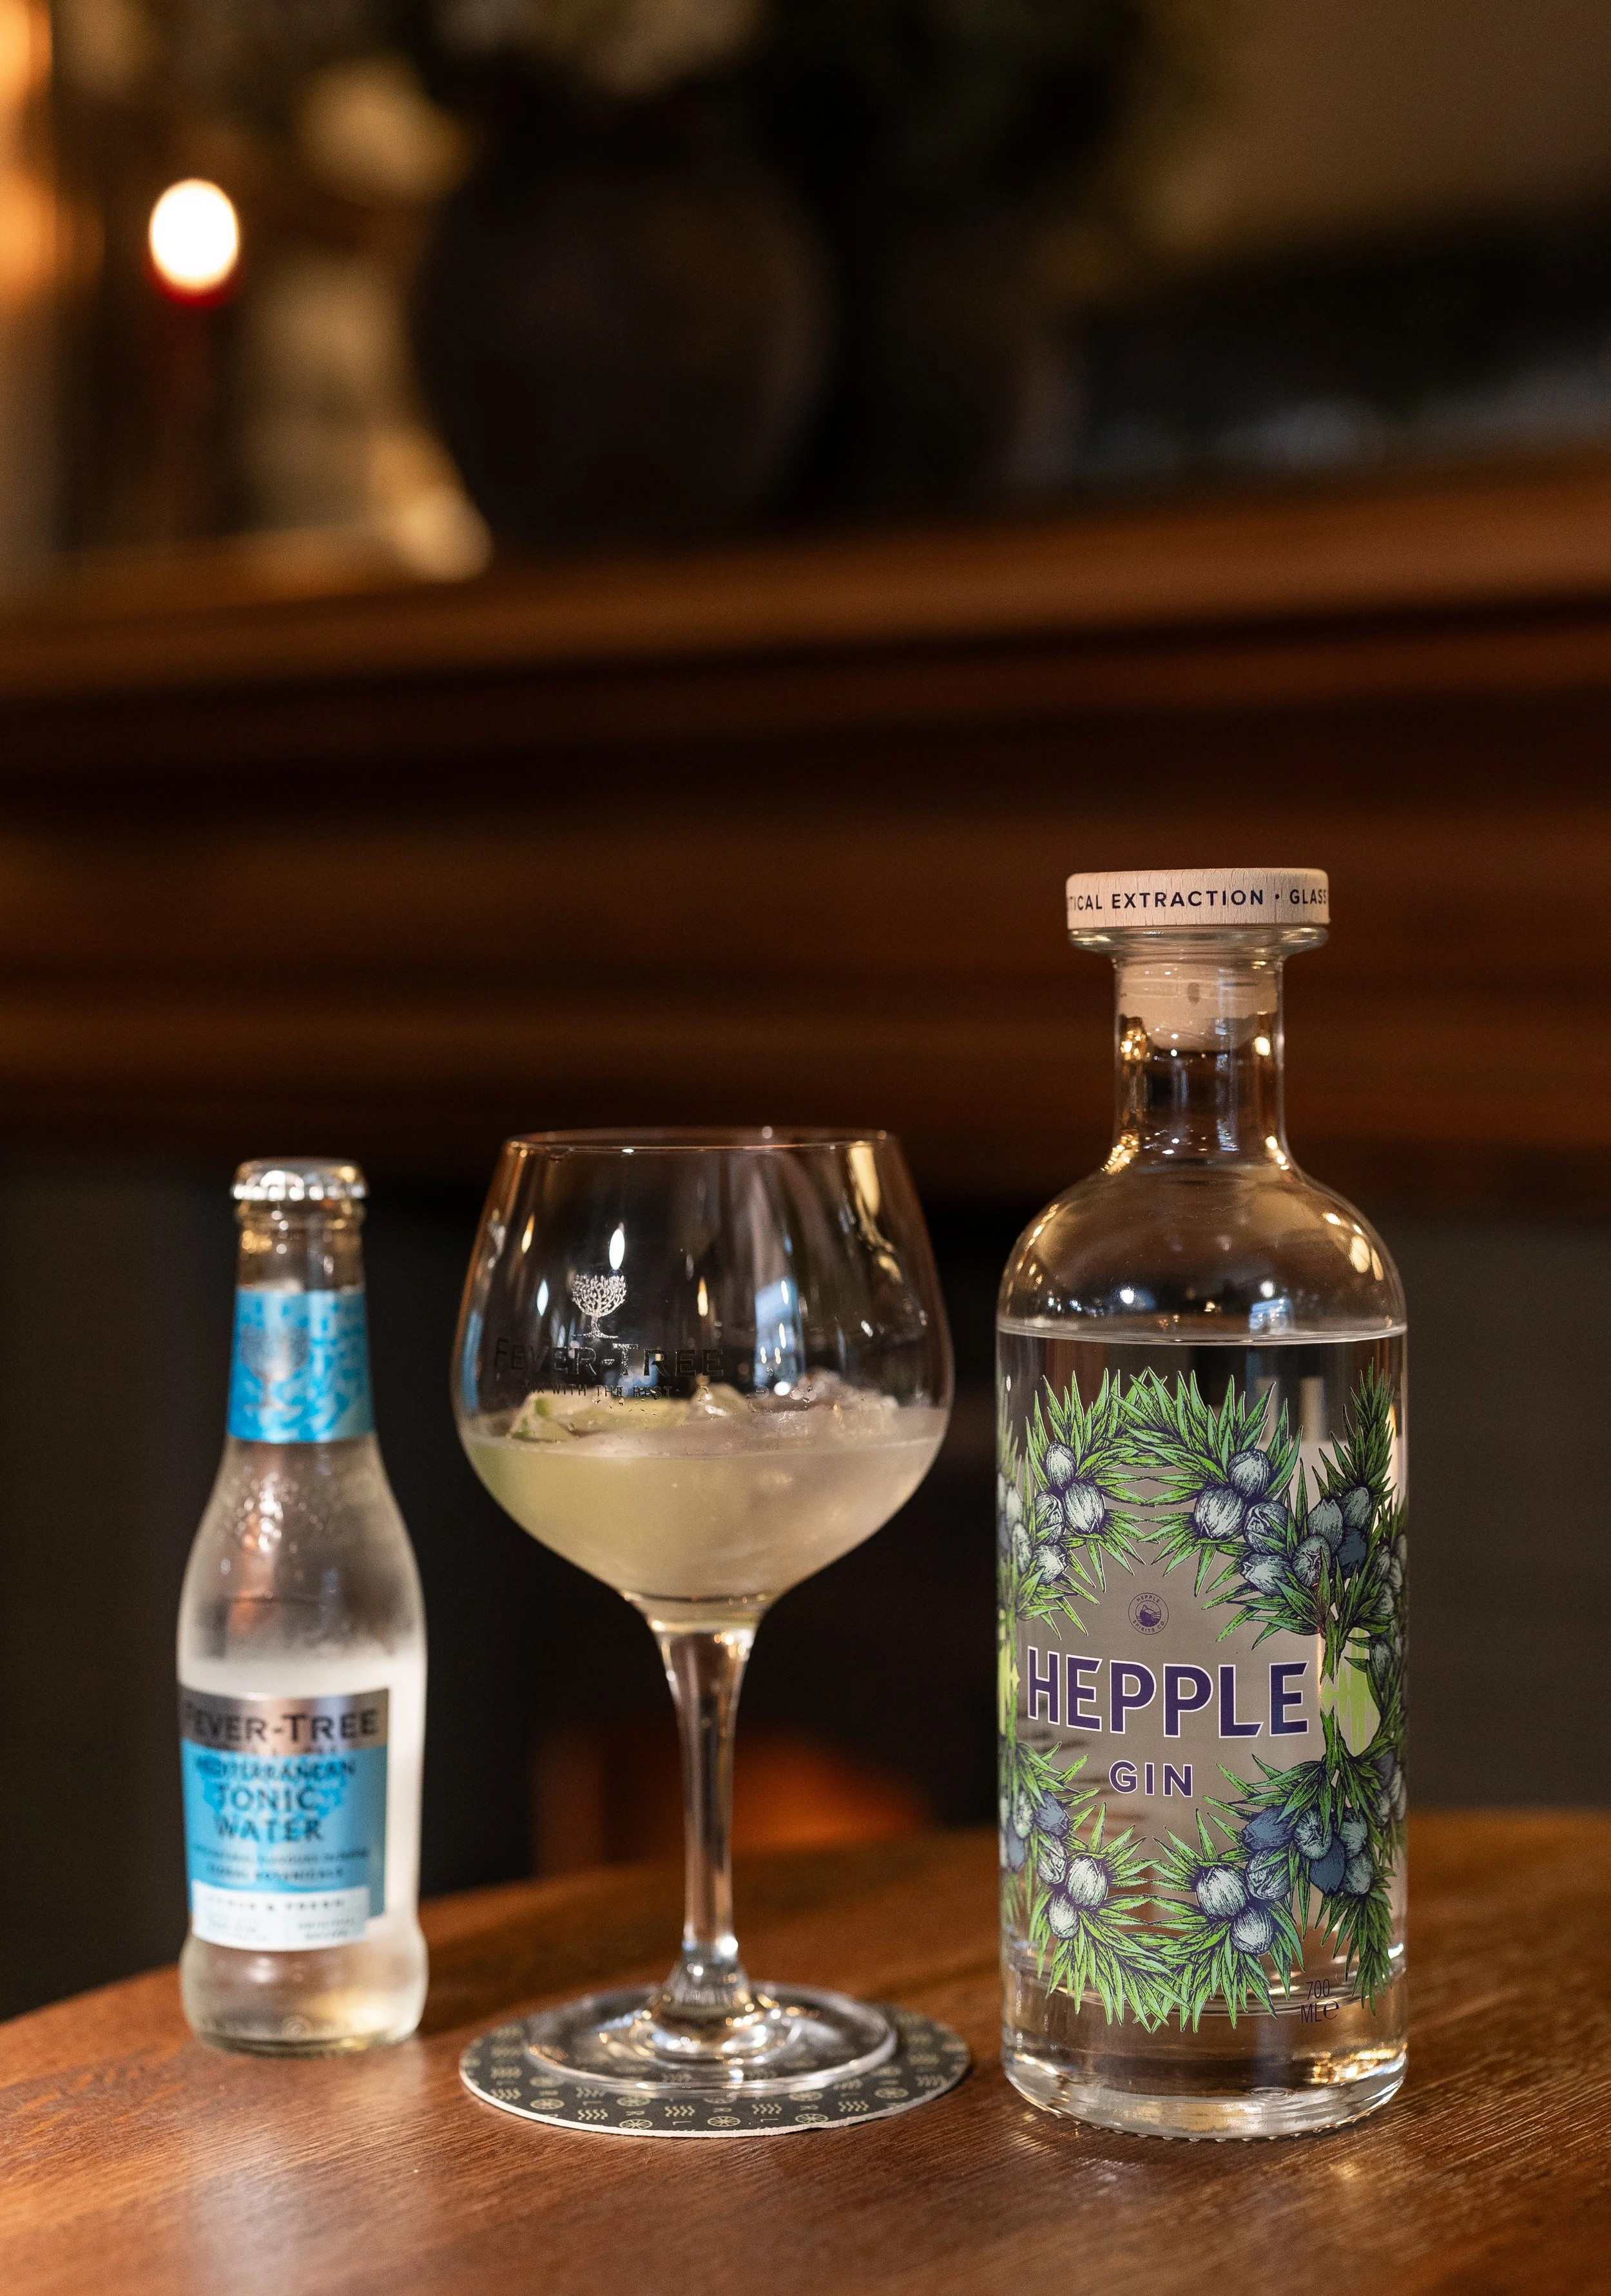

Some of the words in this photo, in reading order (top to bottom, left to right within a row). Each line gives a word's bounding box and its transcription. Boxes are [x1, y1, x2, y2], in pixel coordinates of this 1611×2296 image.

[1112, 889, 1264, 909] EXTRACTION
[552, 1383, 587, 1396] WITH
[595, 1385, 623, 1397] THE
[1136, 1595, 1161, 1603] HEPPLE
[1132, 1619, 1155, 1633] SPIRITS
[1027, 1645, 1309, 1739] HEPPLE
[1108, 1759, 1193, 1797] GIN
[213, 1782, 318, 1812] TONIC
[217, 1814, 323, 1842] WATER
[1306, 1978, 1330, 2000] 700
